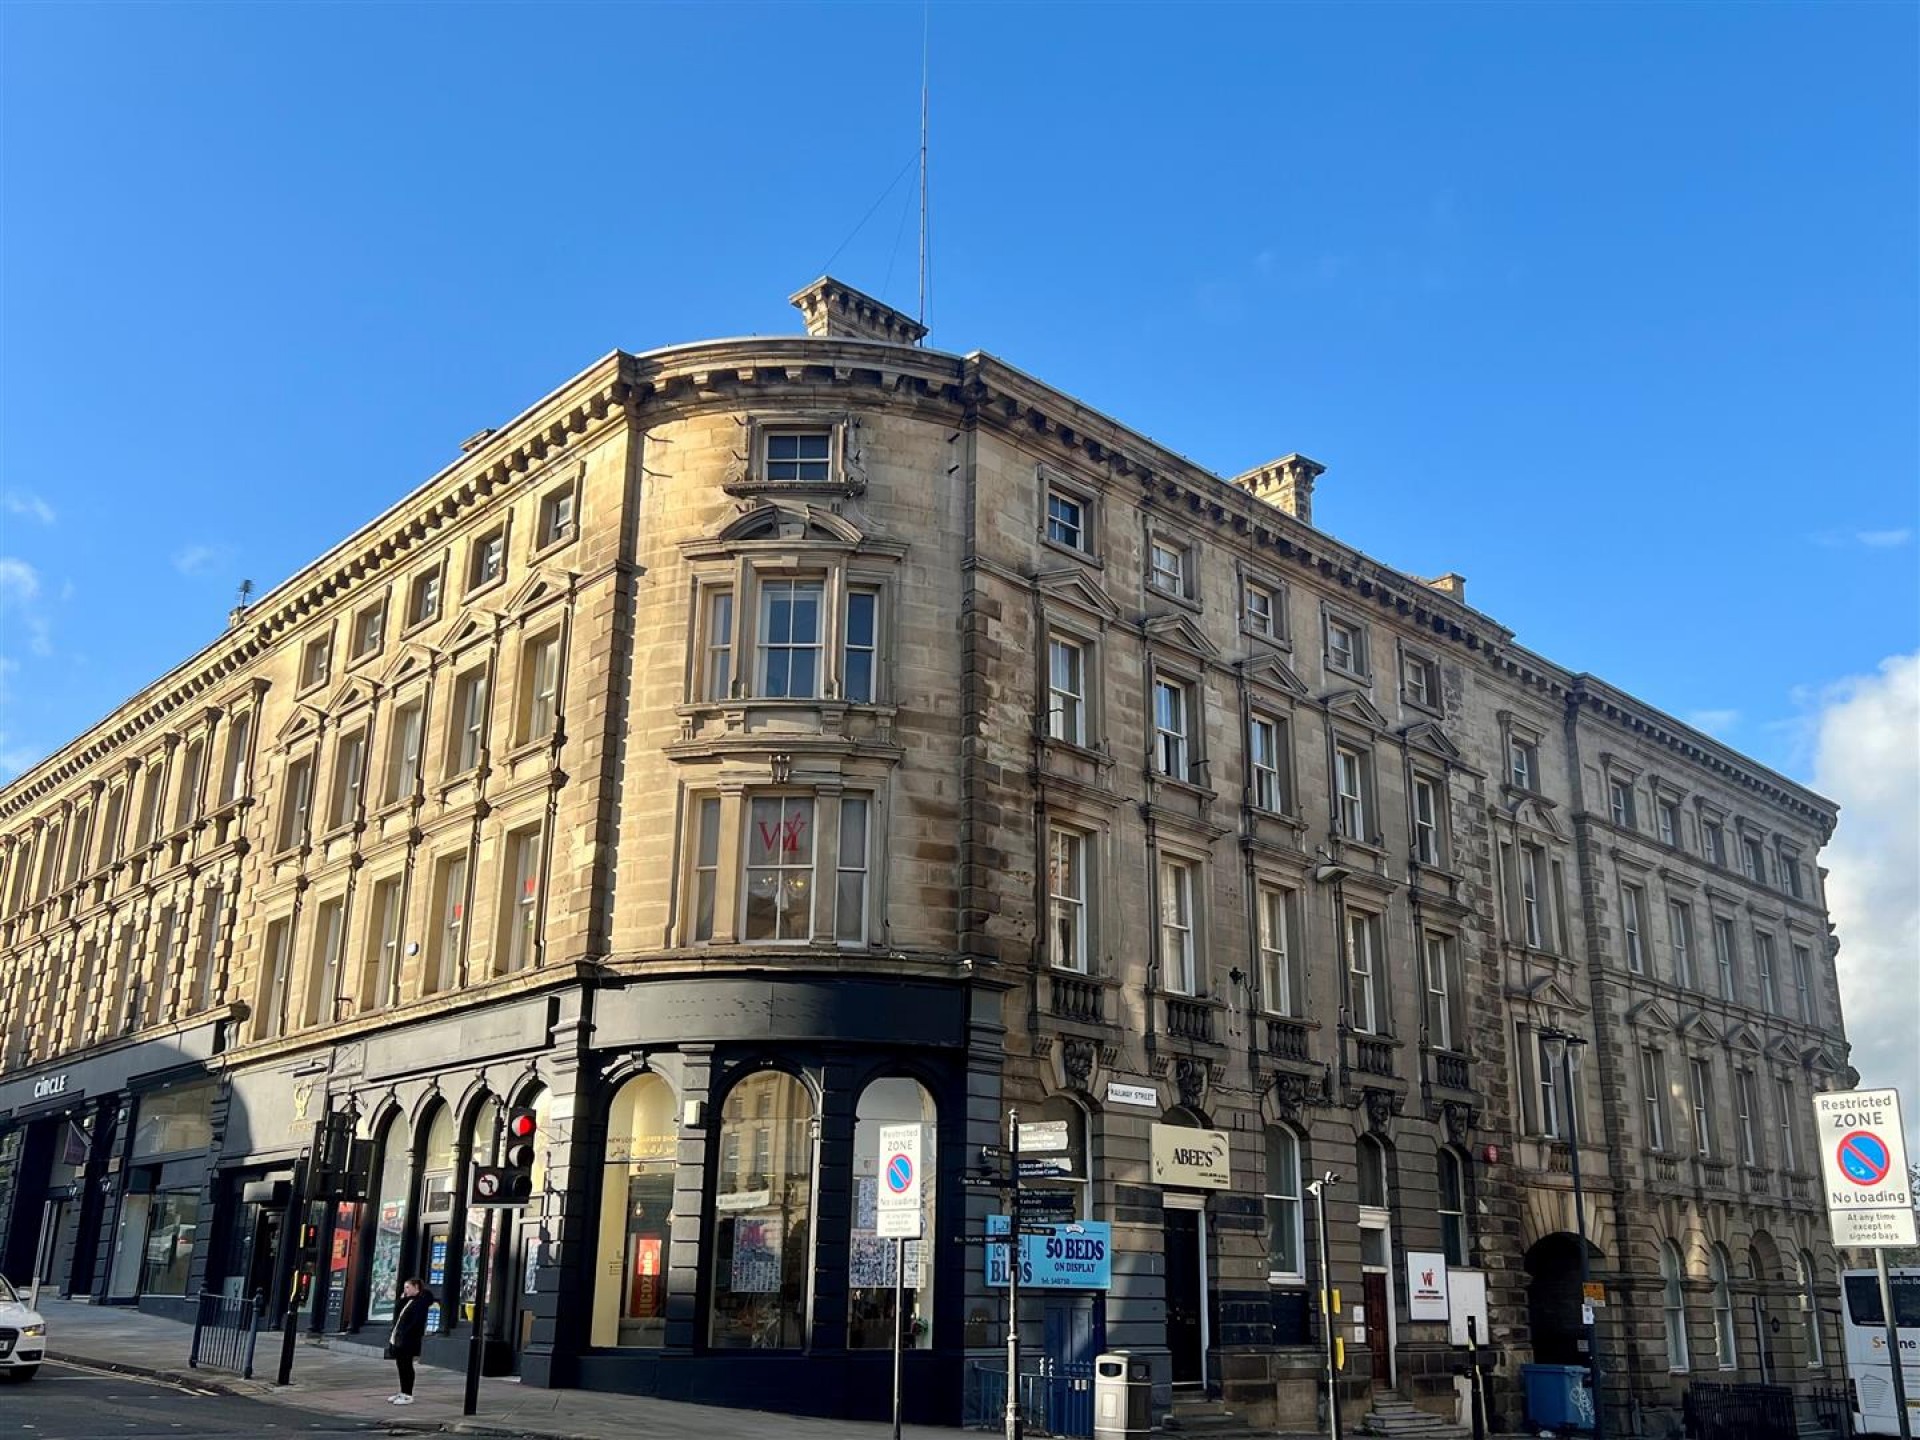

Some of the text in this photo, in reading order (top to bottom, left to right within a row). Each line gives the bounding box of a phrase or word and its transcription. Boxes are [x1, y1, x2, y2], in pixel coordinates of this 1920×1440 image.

[1134, 1091, 1155, 1101] STREET
[1822, 1095, 1891, 1110] Restricted
[1834, 1112, 1883, 1127] ZONE
[888, 1140, 913, 1151] ZONE
[1172, 1148, 1213, 1168] ABEE'S
[1832, 1191, 1905, 1203] No loading
[1848, 1212, 1895, 1222] At any time
[1853, 1222, 1892, 1231] except in
[1849, 1231, 1898, 1241] signed bays
[1046, 1239, 1063, 1258] 50
[1065, 1239, 1104, 1261] BEDS
[991, 1260, 1032, 1283] BS
[1054, 1262, 1096, 1273] ON DISPLAY
